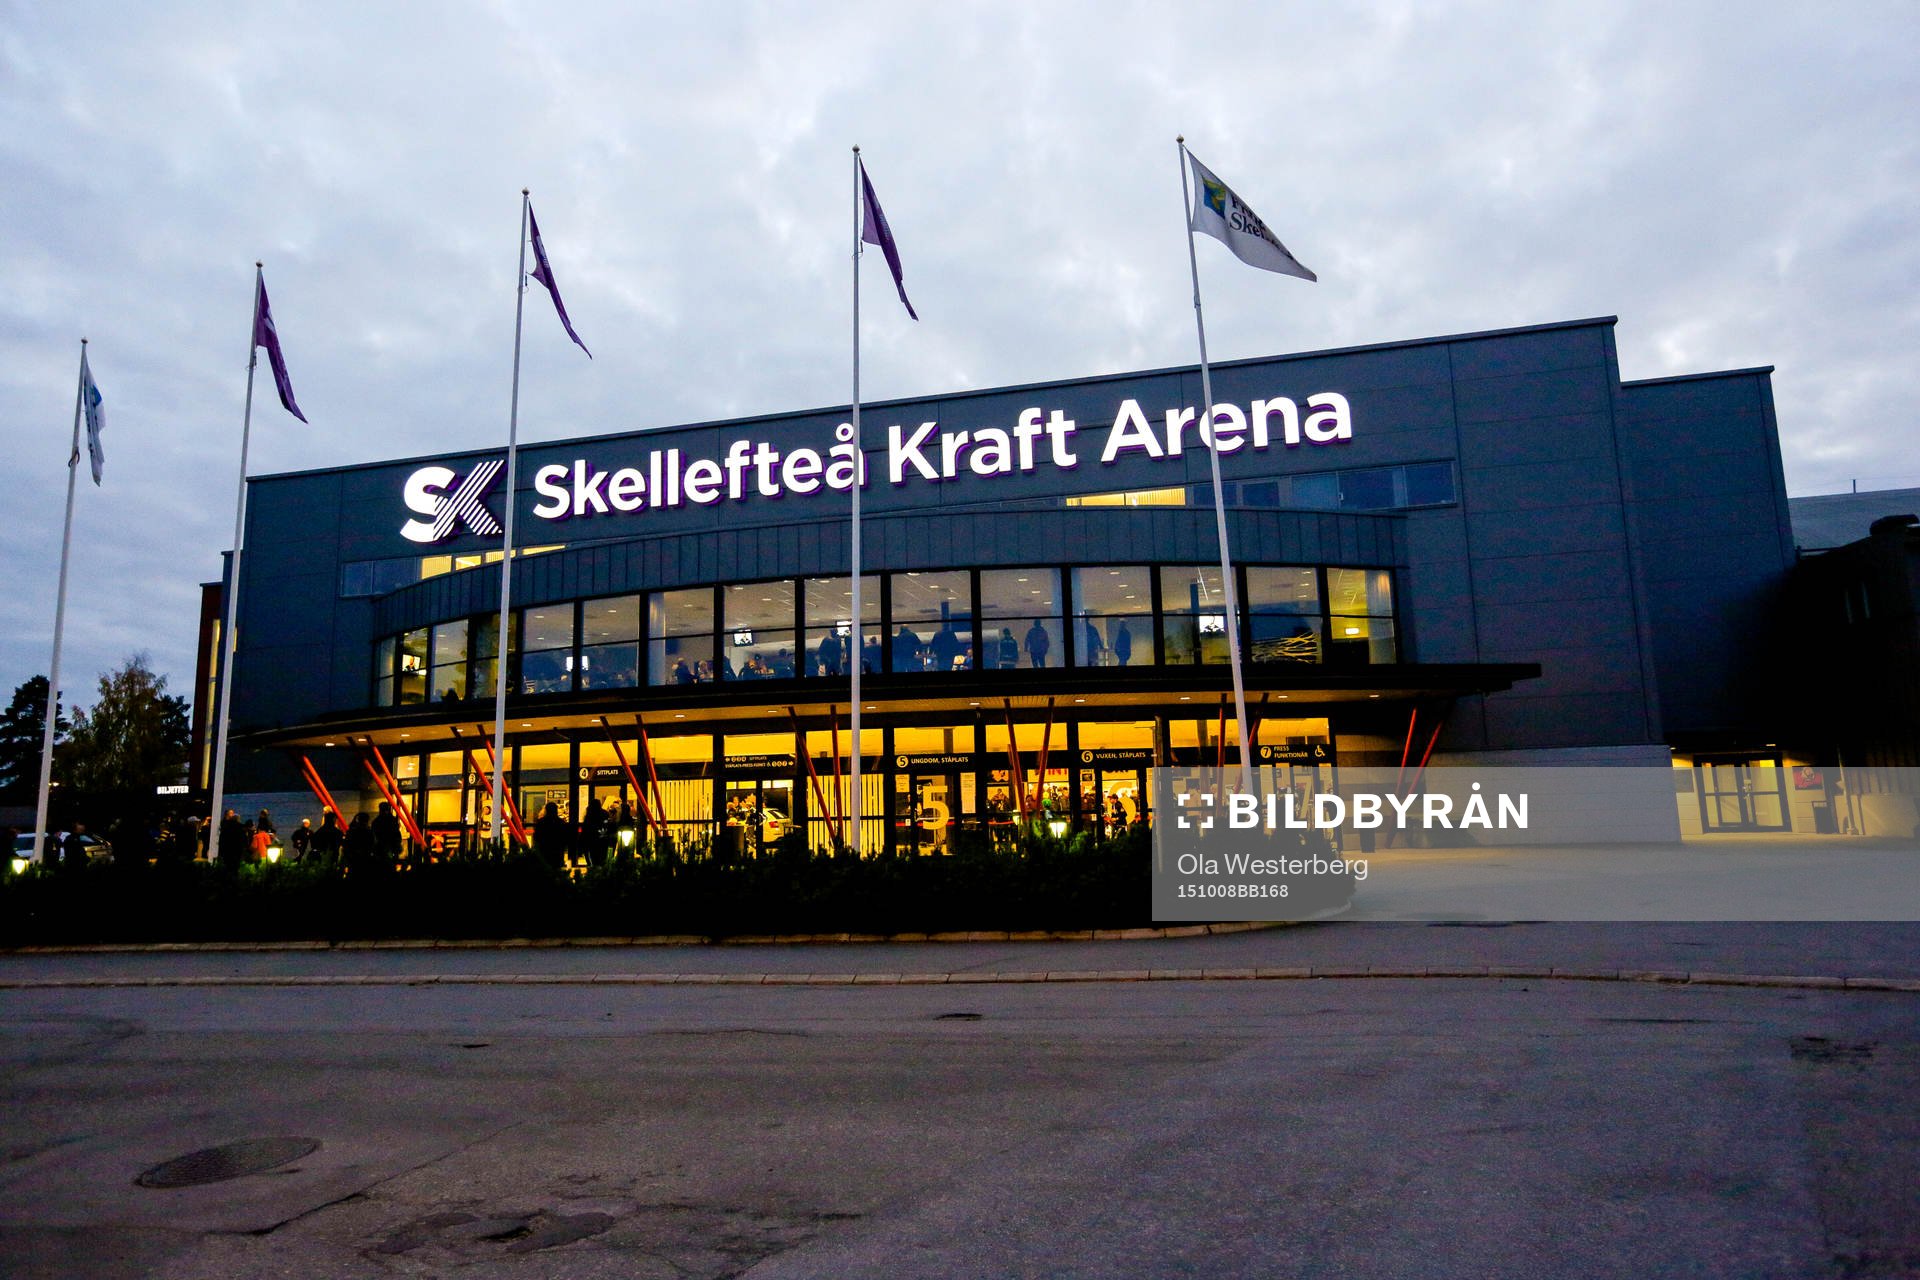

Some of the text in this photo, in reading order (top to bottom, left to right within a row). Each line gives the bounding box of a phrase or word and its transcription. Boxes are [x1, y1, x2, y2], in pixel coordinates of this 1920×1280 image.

[533, 391, 1352, 520] Skellefteå Kraft Arena
[1118, 751, 1146, 759] STÅPLATS
[923, 786, 949, 830] 5
